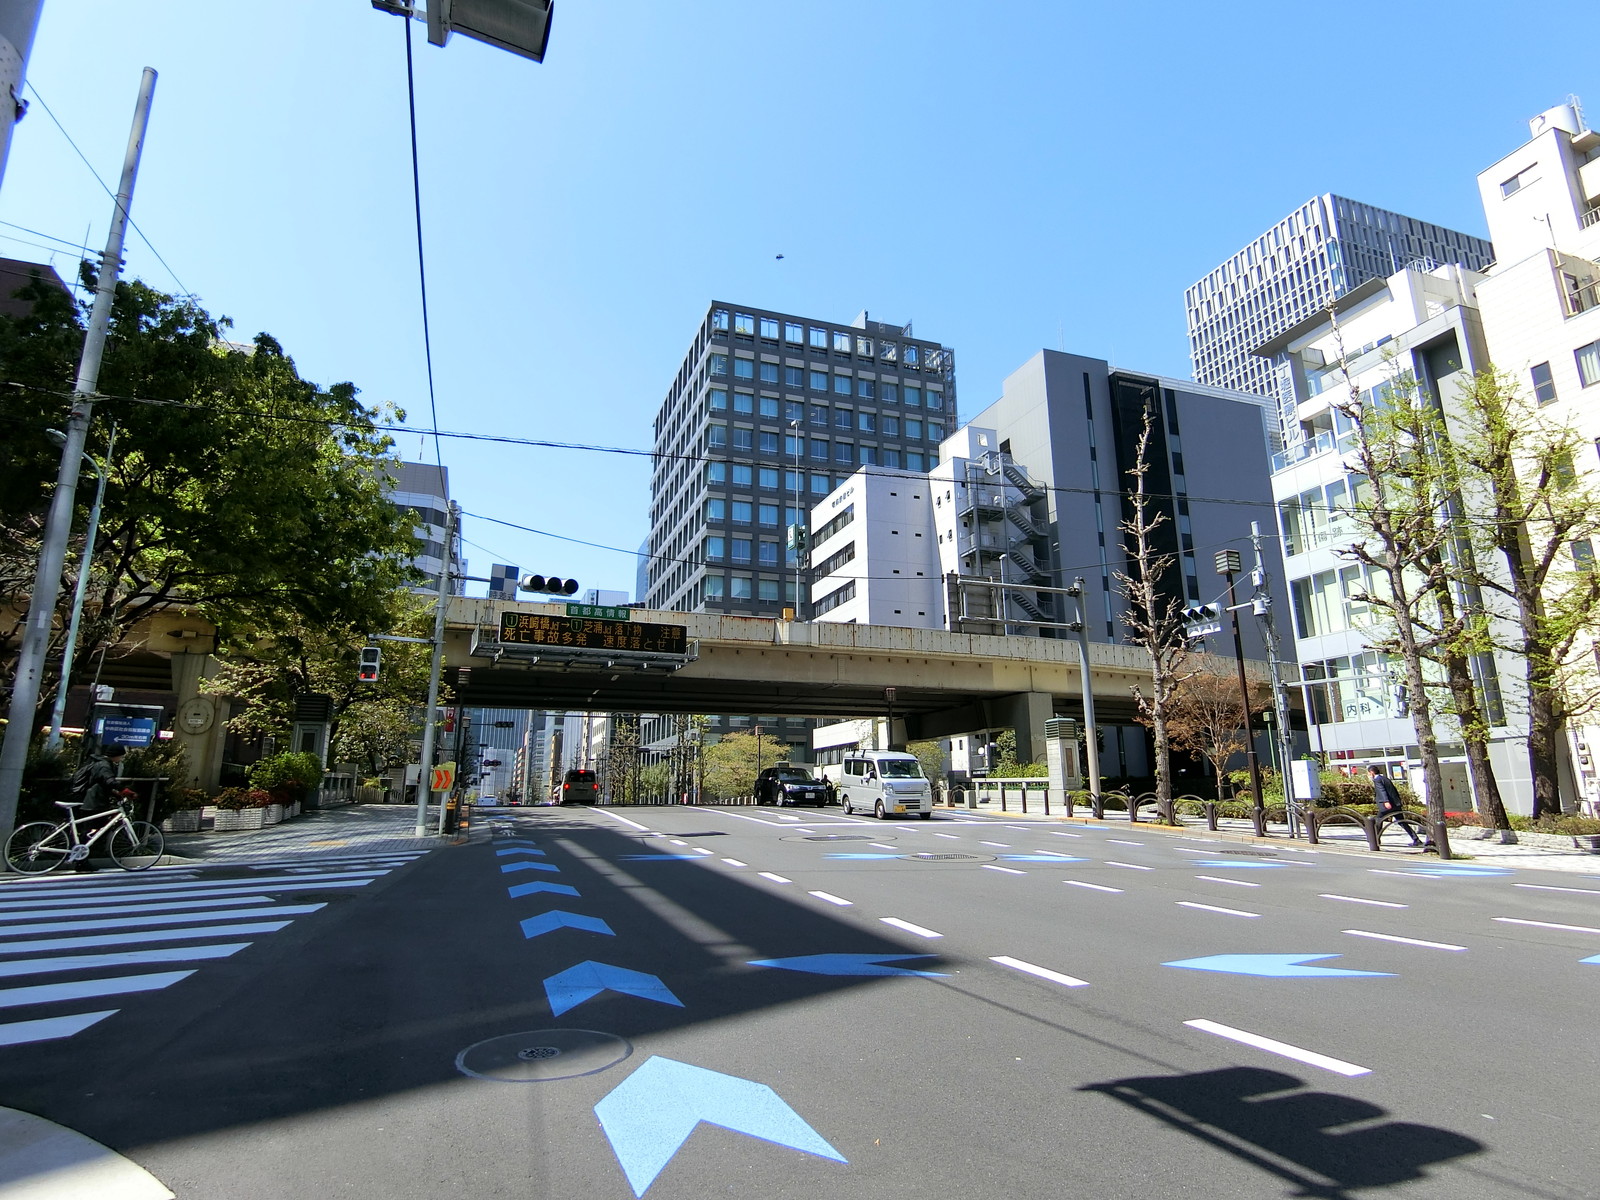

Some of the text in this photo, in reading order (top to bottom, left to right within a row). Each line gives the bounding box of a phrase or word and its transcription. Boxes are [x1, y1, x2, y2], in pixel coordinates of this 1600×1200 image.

[570, 605, 627, 619] 首都高情報
[504, 627, 587, 646] 死亡事故多発
[660, 626, 681, 640] 注意
